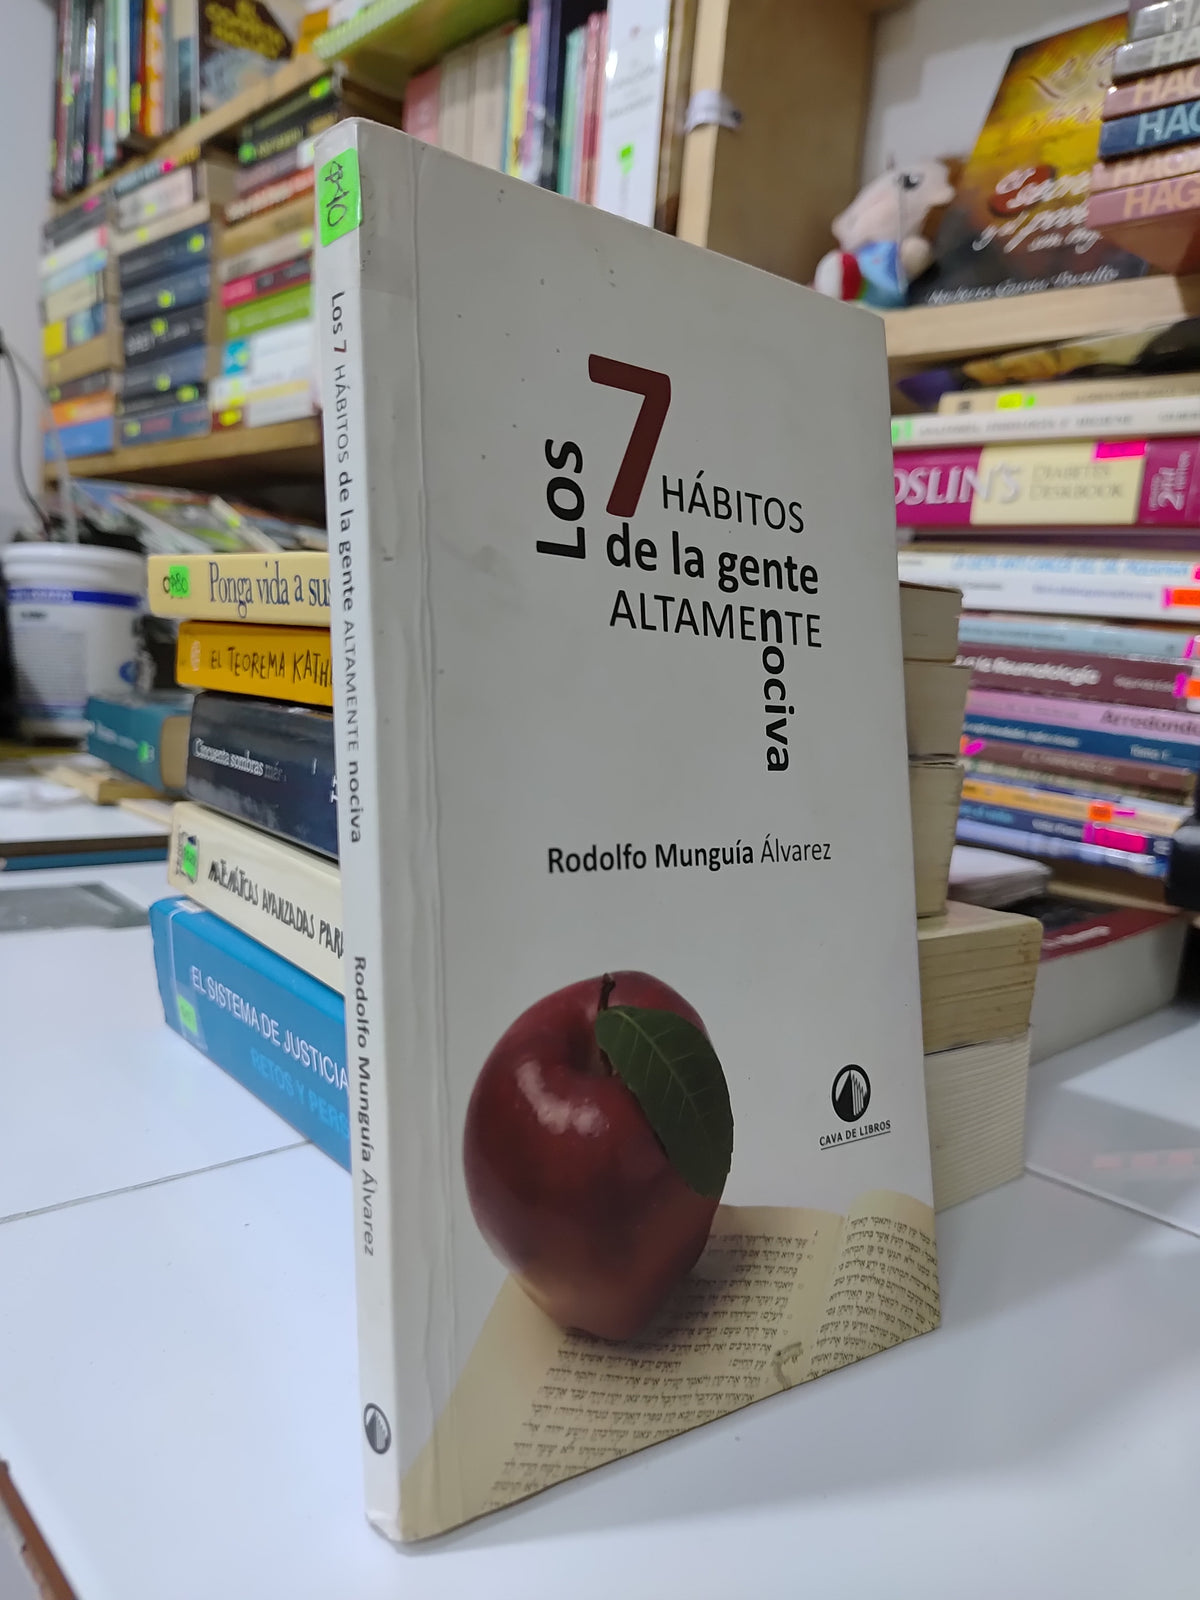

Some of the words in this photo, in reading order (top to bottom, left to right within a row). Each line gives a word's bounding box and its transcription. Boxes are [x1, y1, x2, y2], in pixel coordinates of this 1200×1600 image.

[332, 291, 345, 335] Los
[334, 339, 347, 353] 7
[334, 364, 350, 463] HÁBITOS
[588, 354, 672, 518] 7
[662, 470, 804, 534] HÁBITOS
[339, 472, 353, 501] de
[536, 439, 586, 559] Los
[340, 508, 354, 532] la
[208, 561, 253, 618] Ponga
[256, 561, 290, 606] vida
[294, 574, 304, 602] a
[339, 540, 355, 611] gente
[606, 522, 657, 571] de
[672, 531, 704, 579] la
[718, 551, 818, 594] gente
[211, 650, 222, 669] EL
[228, 646, 286, 679] TEOREMA
[293, 649, 333, 687] KATH
[343, 620, 360, 751] ALTAMENTE
[230, 750, 264, 777] sombras
[349, 761, 364, 843] nociva
[549, 843, 647, 874] Rodolfo
[655, 840, 753, 871] Munguía
[761, 834, 831, 863] Álvarez
[262, 888, 315, 939] AVANZADAS
[191, 965, 206, 994] EL
[207, 976, 260, 1032] SISTEMA
[261, 1013, 281, 1046] DE
[284, 1030, 349, 1090] JUSTICIA
[354, 956, 370, 1048] Rodolfo
[252, 1048, 295, 1097] RETOS
[358, 1056, 375, 1162] Munguía
[820, 1132, 843, 1147] CAVA
[845, 1128, 857, 1140] DE
[859, 1119, 892, 1137] LIBROS
[362, 1168, 379, 1257] Álvarez
